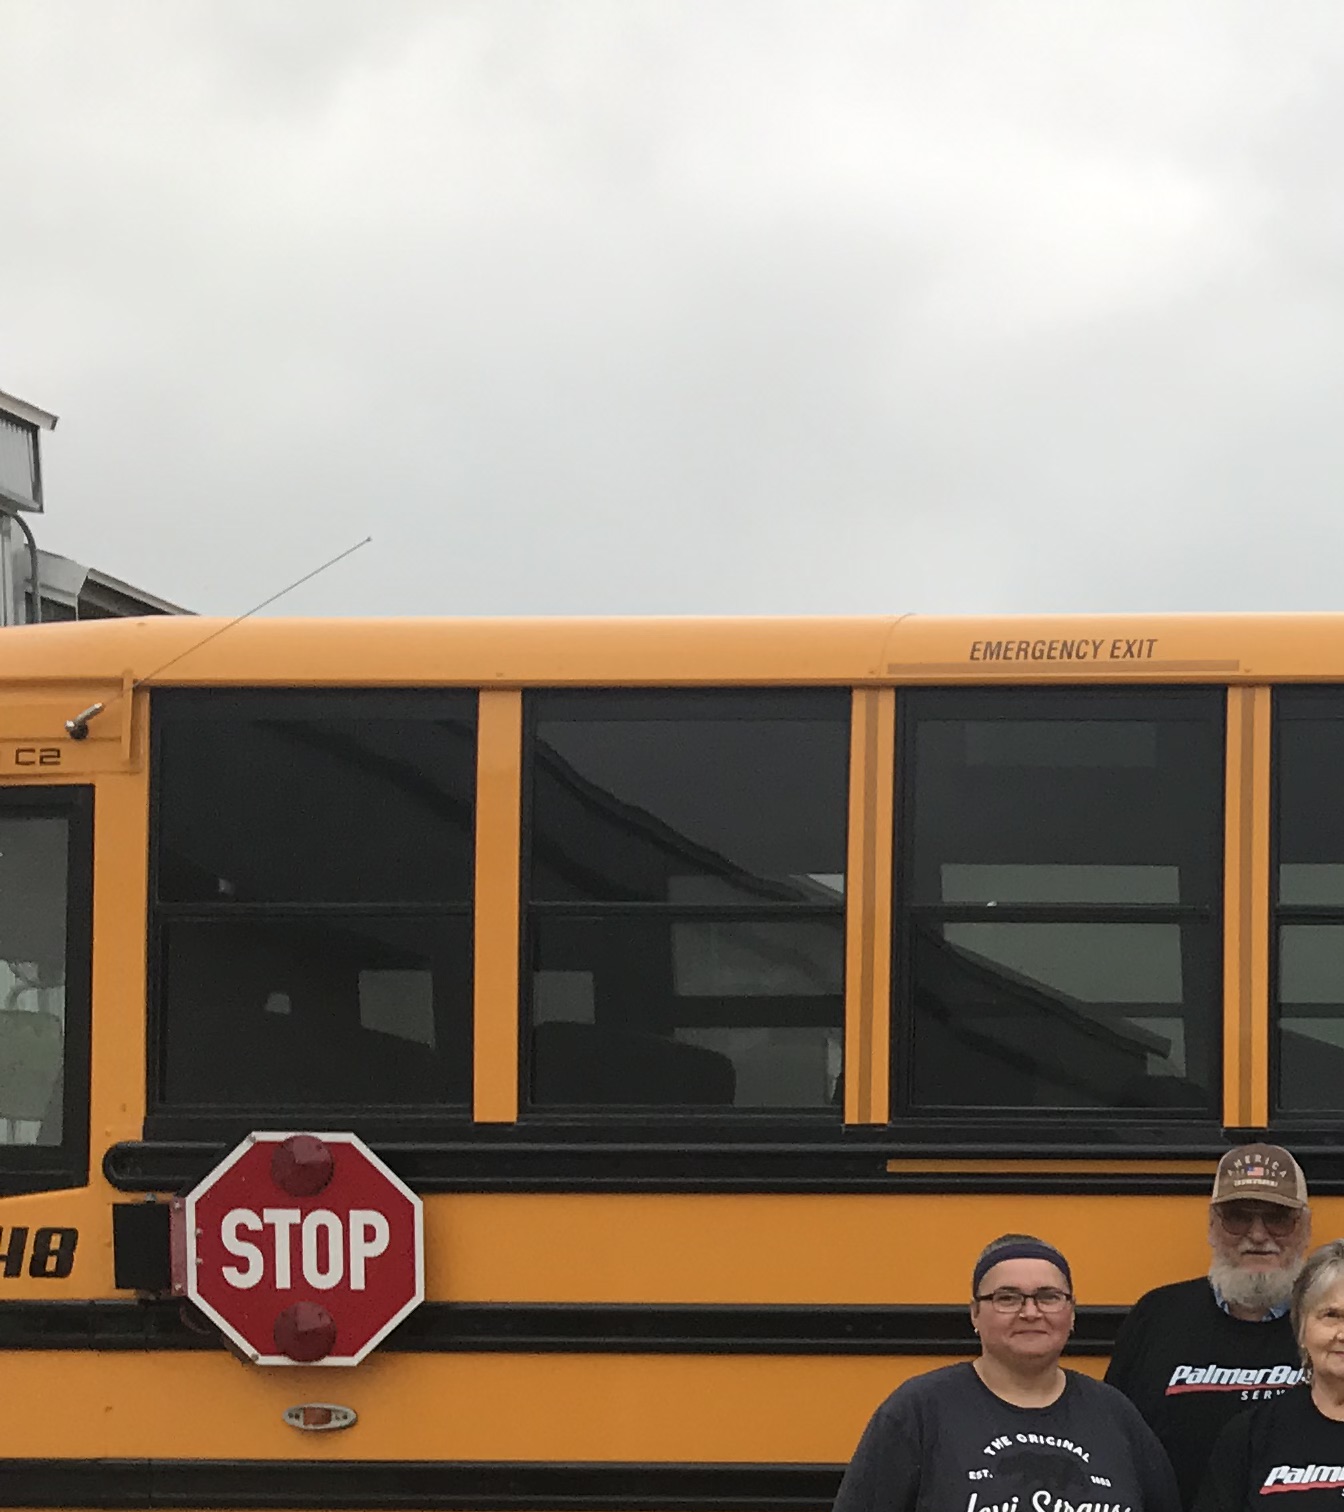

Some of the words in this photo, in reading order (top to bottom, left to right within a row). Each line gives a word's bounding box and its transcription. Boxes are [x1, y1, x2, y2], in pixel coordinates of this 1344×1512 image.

[969, 639, 1104, 661] EMERGENCY
[1109, 638, 1158, 659] EXIT
[15, 748, 61, 766] C2
[221, 1207, 390, 1290] STOP
[983, 1435, 1012, 1456] THE
[1016, 1433, 1090, 1463] ORIGINAL
